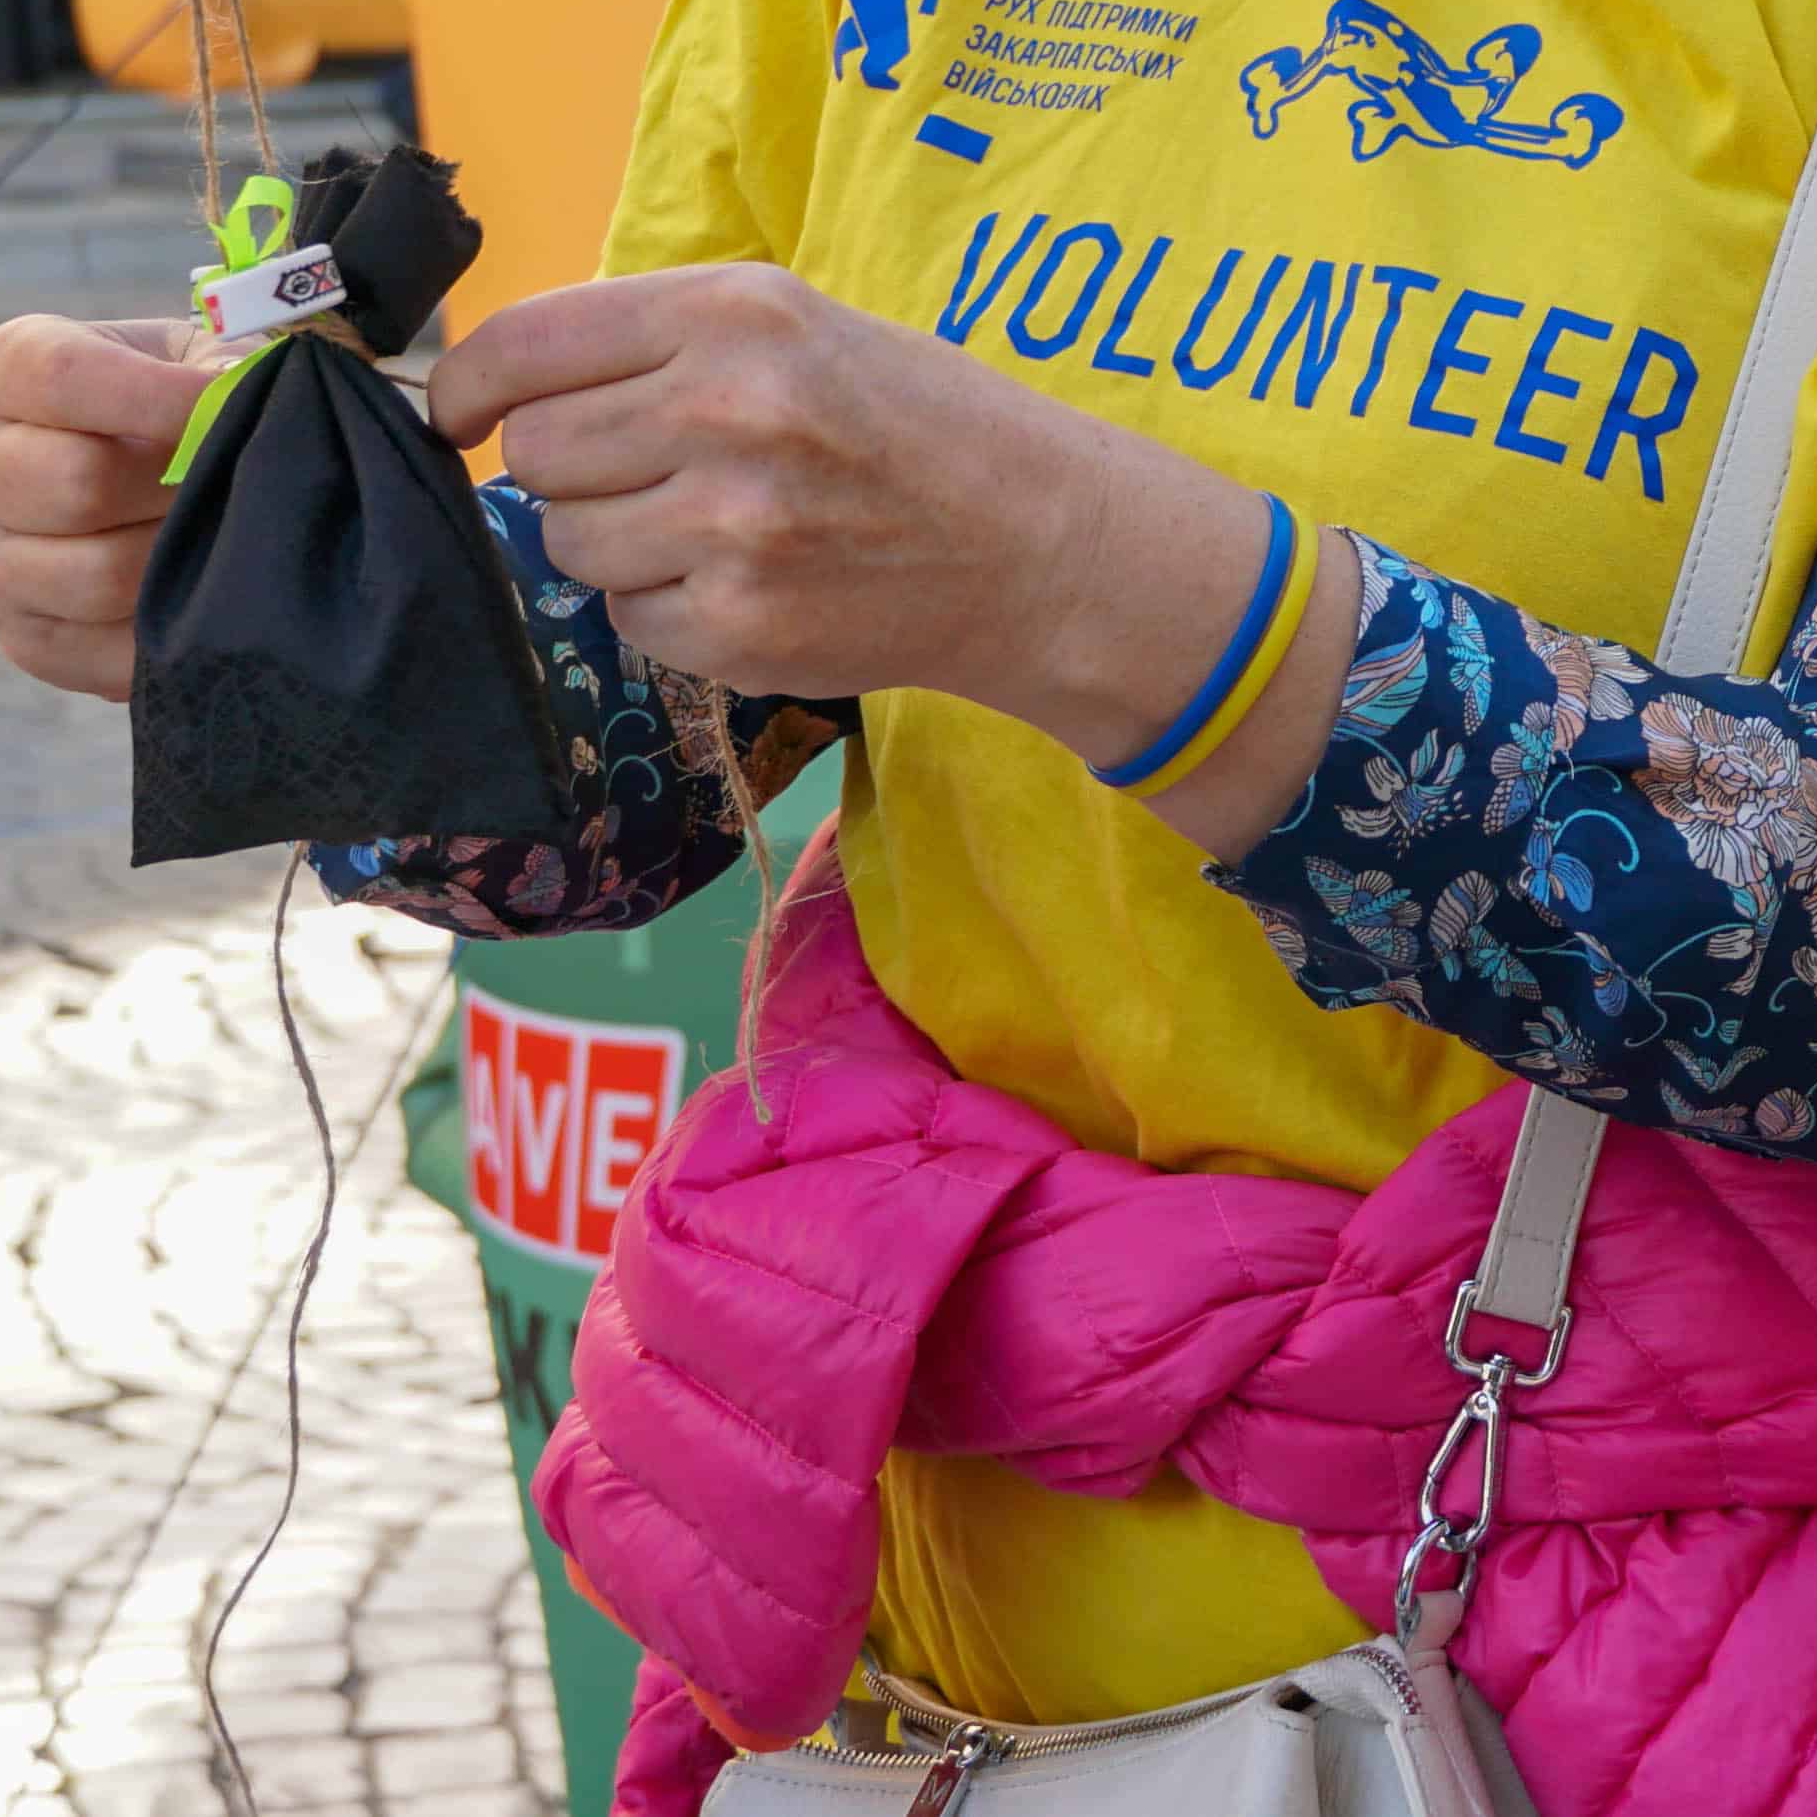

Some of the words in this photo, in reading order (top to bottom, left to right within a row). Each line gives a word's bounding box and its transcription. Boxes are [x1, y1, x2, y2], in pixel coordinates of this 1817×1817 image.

[1046, 0, 1199, 43] ПІДТРИМКИ
[965, 24, 1185, 81] ЗАКАРПАТСЬКИХ
[943, 59, 1111, 113] ВІЙСЬКОВИХ
[934, 210, 1701, 504] VOLUNTEER
[469, 1049, 654, 1214] AVE
